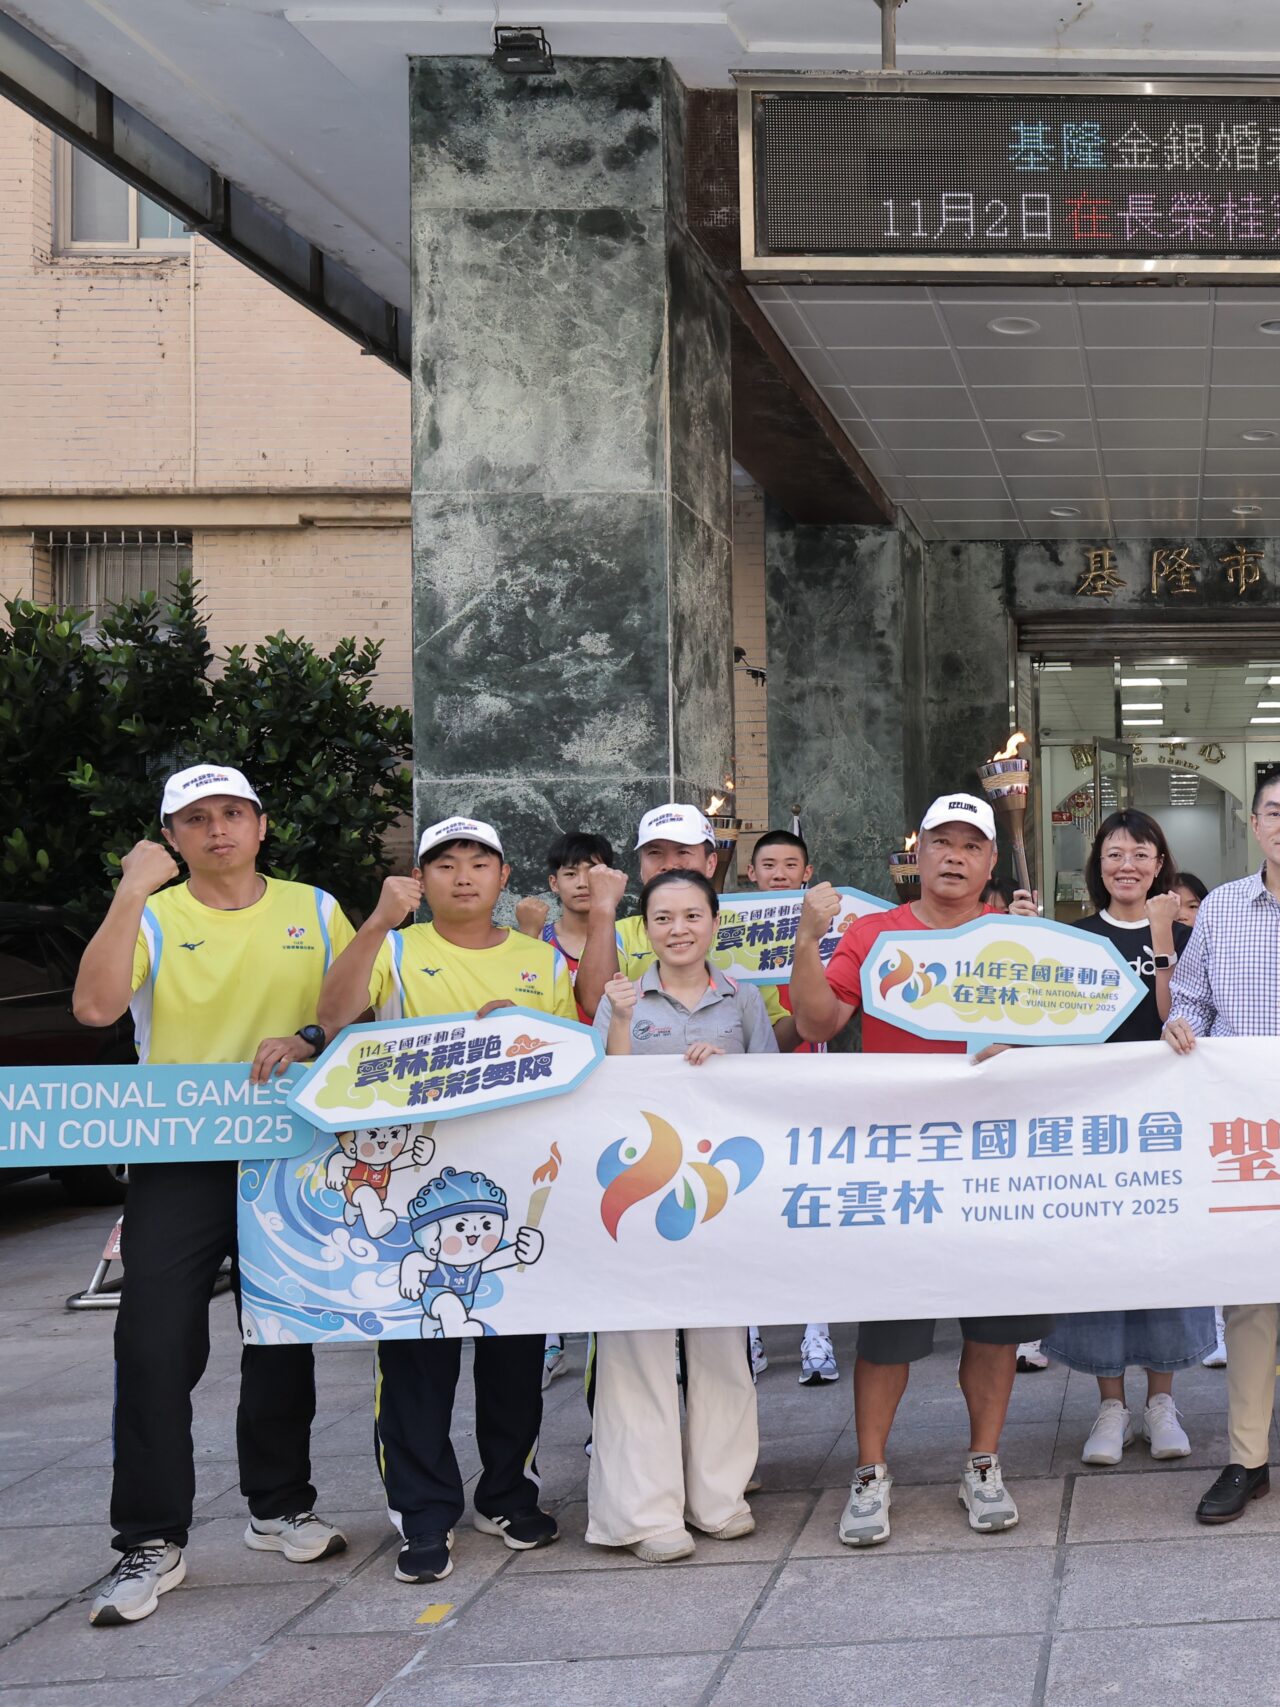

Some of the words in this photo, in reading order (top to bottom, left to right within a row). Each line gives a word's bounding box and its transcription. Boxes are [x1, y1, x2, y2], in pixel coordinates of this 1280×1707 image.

[948, 801, 978, 814] KEELUNG
[955, 960, 1121, 987] 114年全國運動會
[953, 983, 1020, 1006] 在雲林
[1026, 1000, 1057, 1009] YUNLIN
[1059, 1001, 1093, 1011] COUNTY
[1095, 1003, 1116, 1012] 2025
[1027, 988, 1043, 997] THE
[1046, 988, 1088, 999] NATIONAL
[1089, 991, 1119, 1001] GAMES
[360, 1027, 466, 1058] 114全國運動會
[407, 1051, 554, 1106] 精彩無限
[0, 1081, 167, 1111] NATIONAL
[176, 1078, 295, 1107] GAMES
[58, 1117, 206, 1149] COUNTY
[214, 1115, 293, 1145] 2025
[785, 1111, 1183, 1165] 114年全國運動會
[962, 1177, 1000, 1194] THE
[1008, 1173, 1107, 1193] NATIONAL
[1115, 1169, 1183, 1188] GAMES
[781, 1179, 944, 1229] 在雲林
[961, 1203, 1035, 1222] YUNLIN
[1043, 1200, 1124, 1219] COUNTY
[1132, 1198, 1180, 1215] 2025
